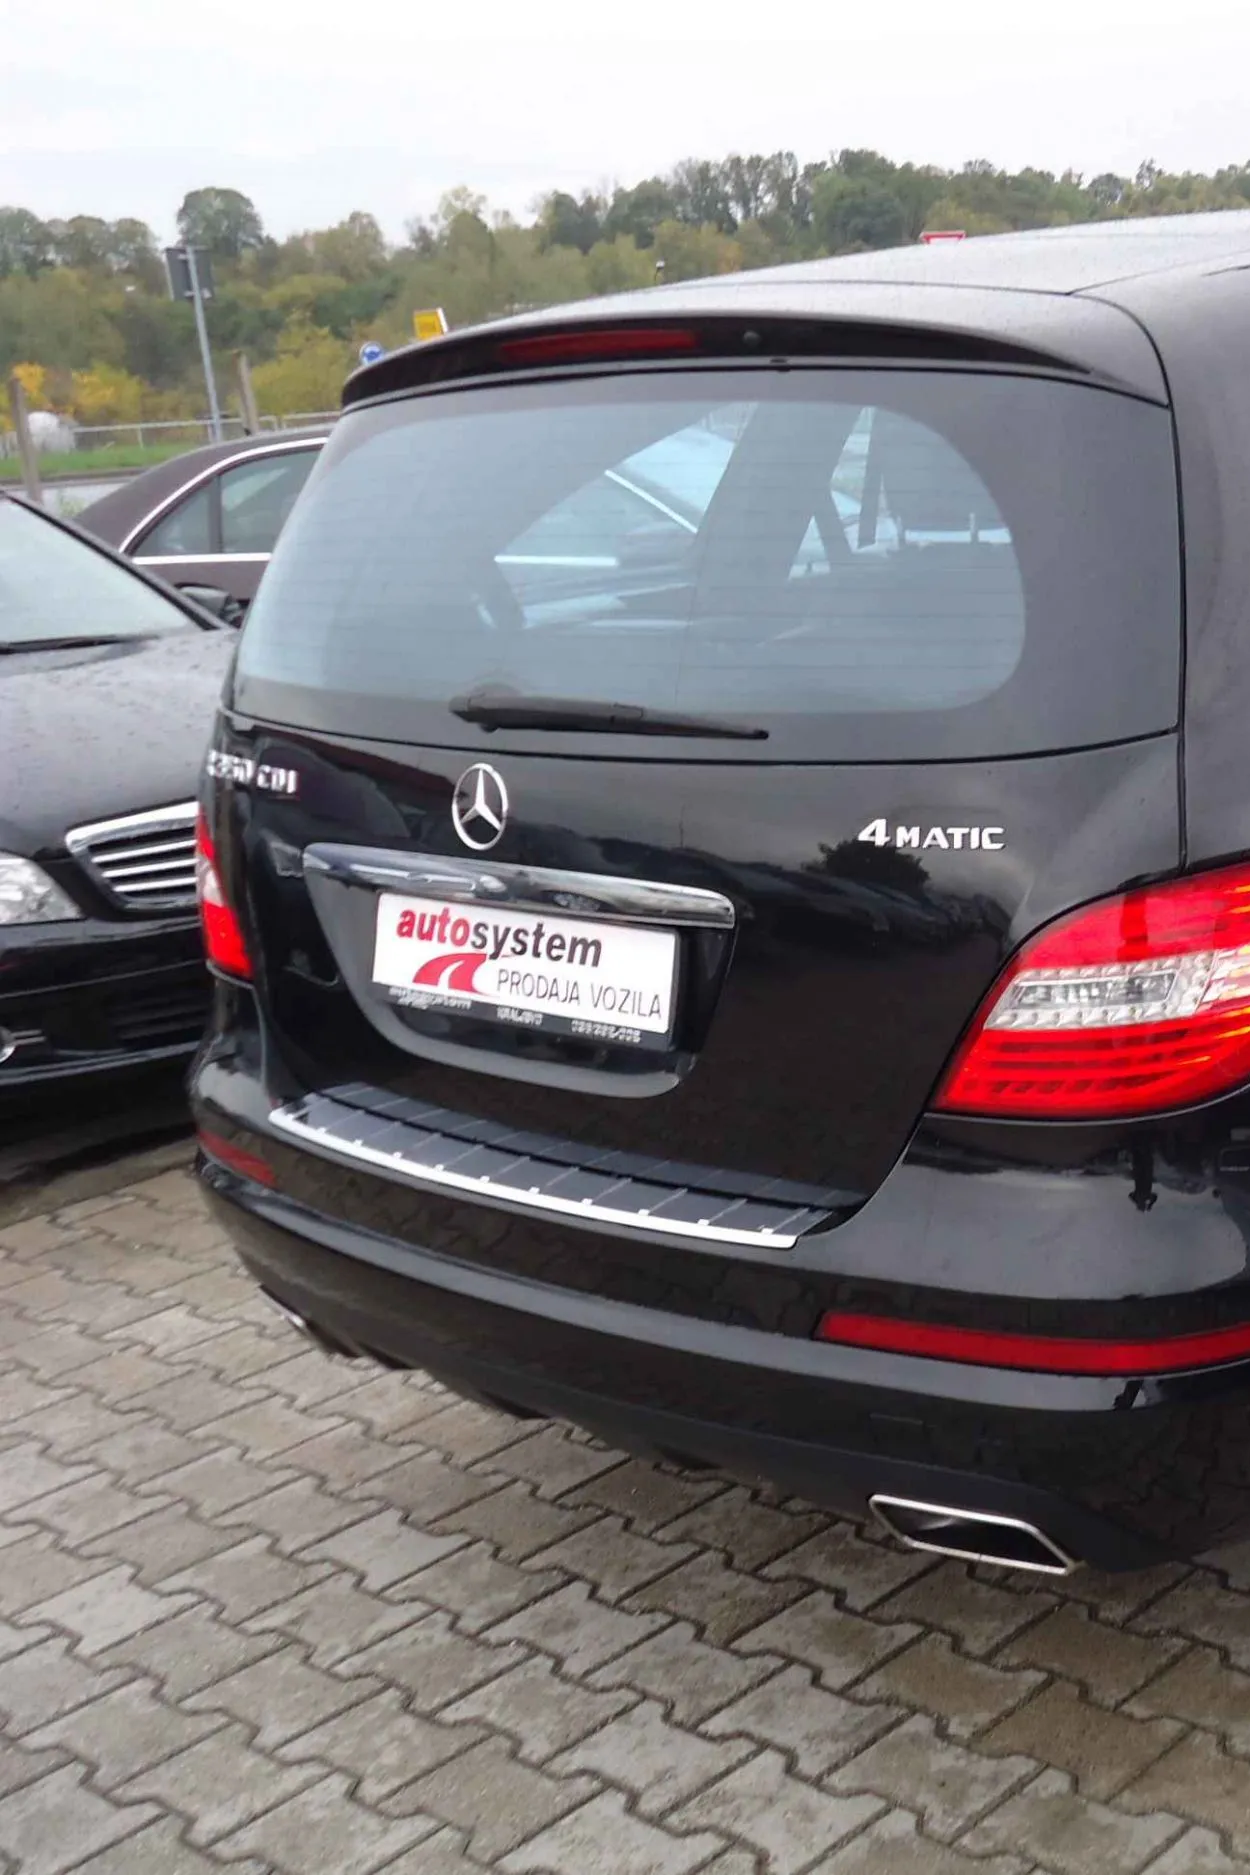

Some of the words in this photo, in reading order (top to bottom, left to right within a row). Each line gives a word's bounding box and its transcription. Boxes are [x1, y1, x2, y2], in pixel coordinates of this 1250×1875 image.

[257, 764, 298, 793] CDI
[396, 907, 602, 967] autosystem
[497, 968, 580, 1006] PRODAJA
[589, 986, 662, 1020] VOZILA
